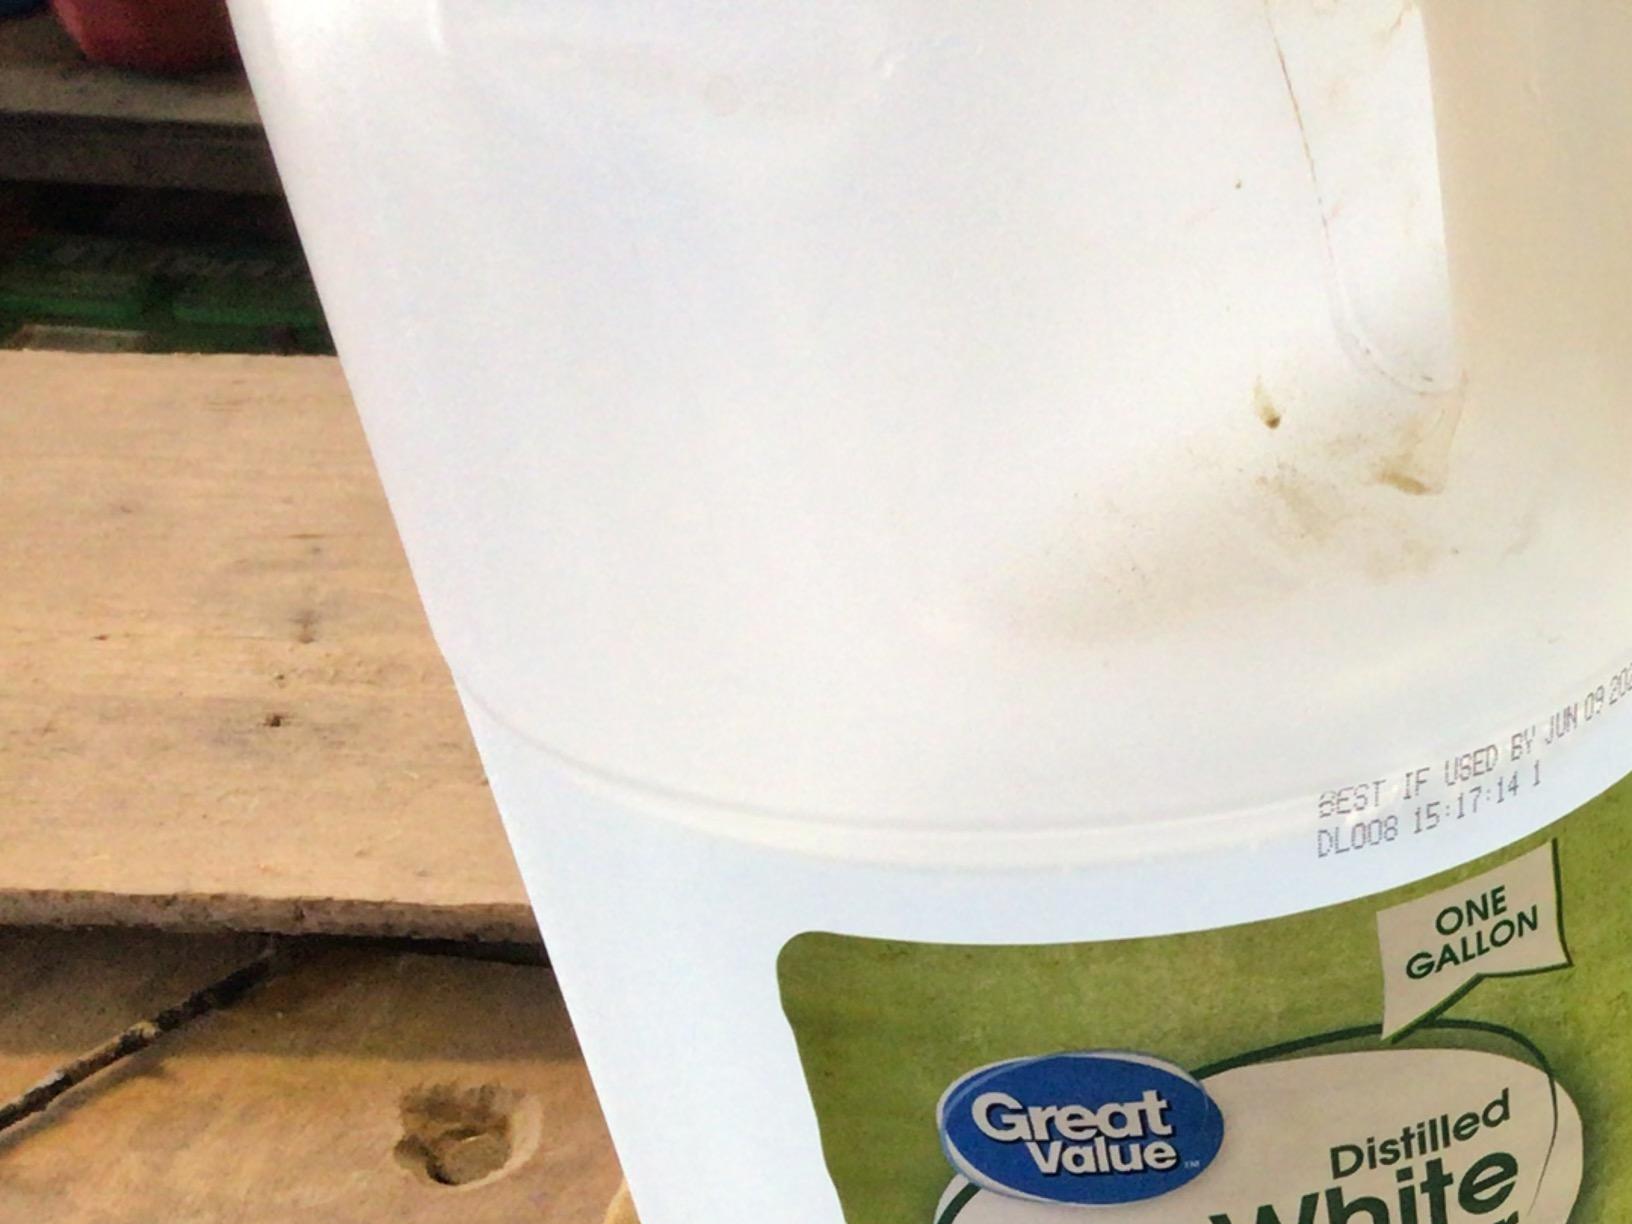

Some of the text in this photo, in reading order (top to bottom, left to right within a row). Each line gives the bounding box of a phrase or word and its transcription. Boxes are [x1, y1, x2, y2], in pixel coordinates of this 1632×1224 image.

[1318, 779, 1386, 818] BEST
[1403, 767, 1430, 800] IF
[1444, 744, 1498, 787] USED
[1510, 725, 1537, 762] BY
[1544, 703, 1578, 745] JUN
[1583, 684, 1605, 721] 09
[1413, 770, 1520, 834] 15:17:14
[1405, 904, 1538, 979] GALLON
[1435, 885, 1508, 935] ONE
[972, 1090, 1173, 1142] Great
[1330, 1087, 1511, 1179] Distilled
[1026, 1137, 1178, 1175] Value
